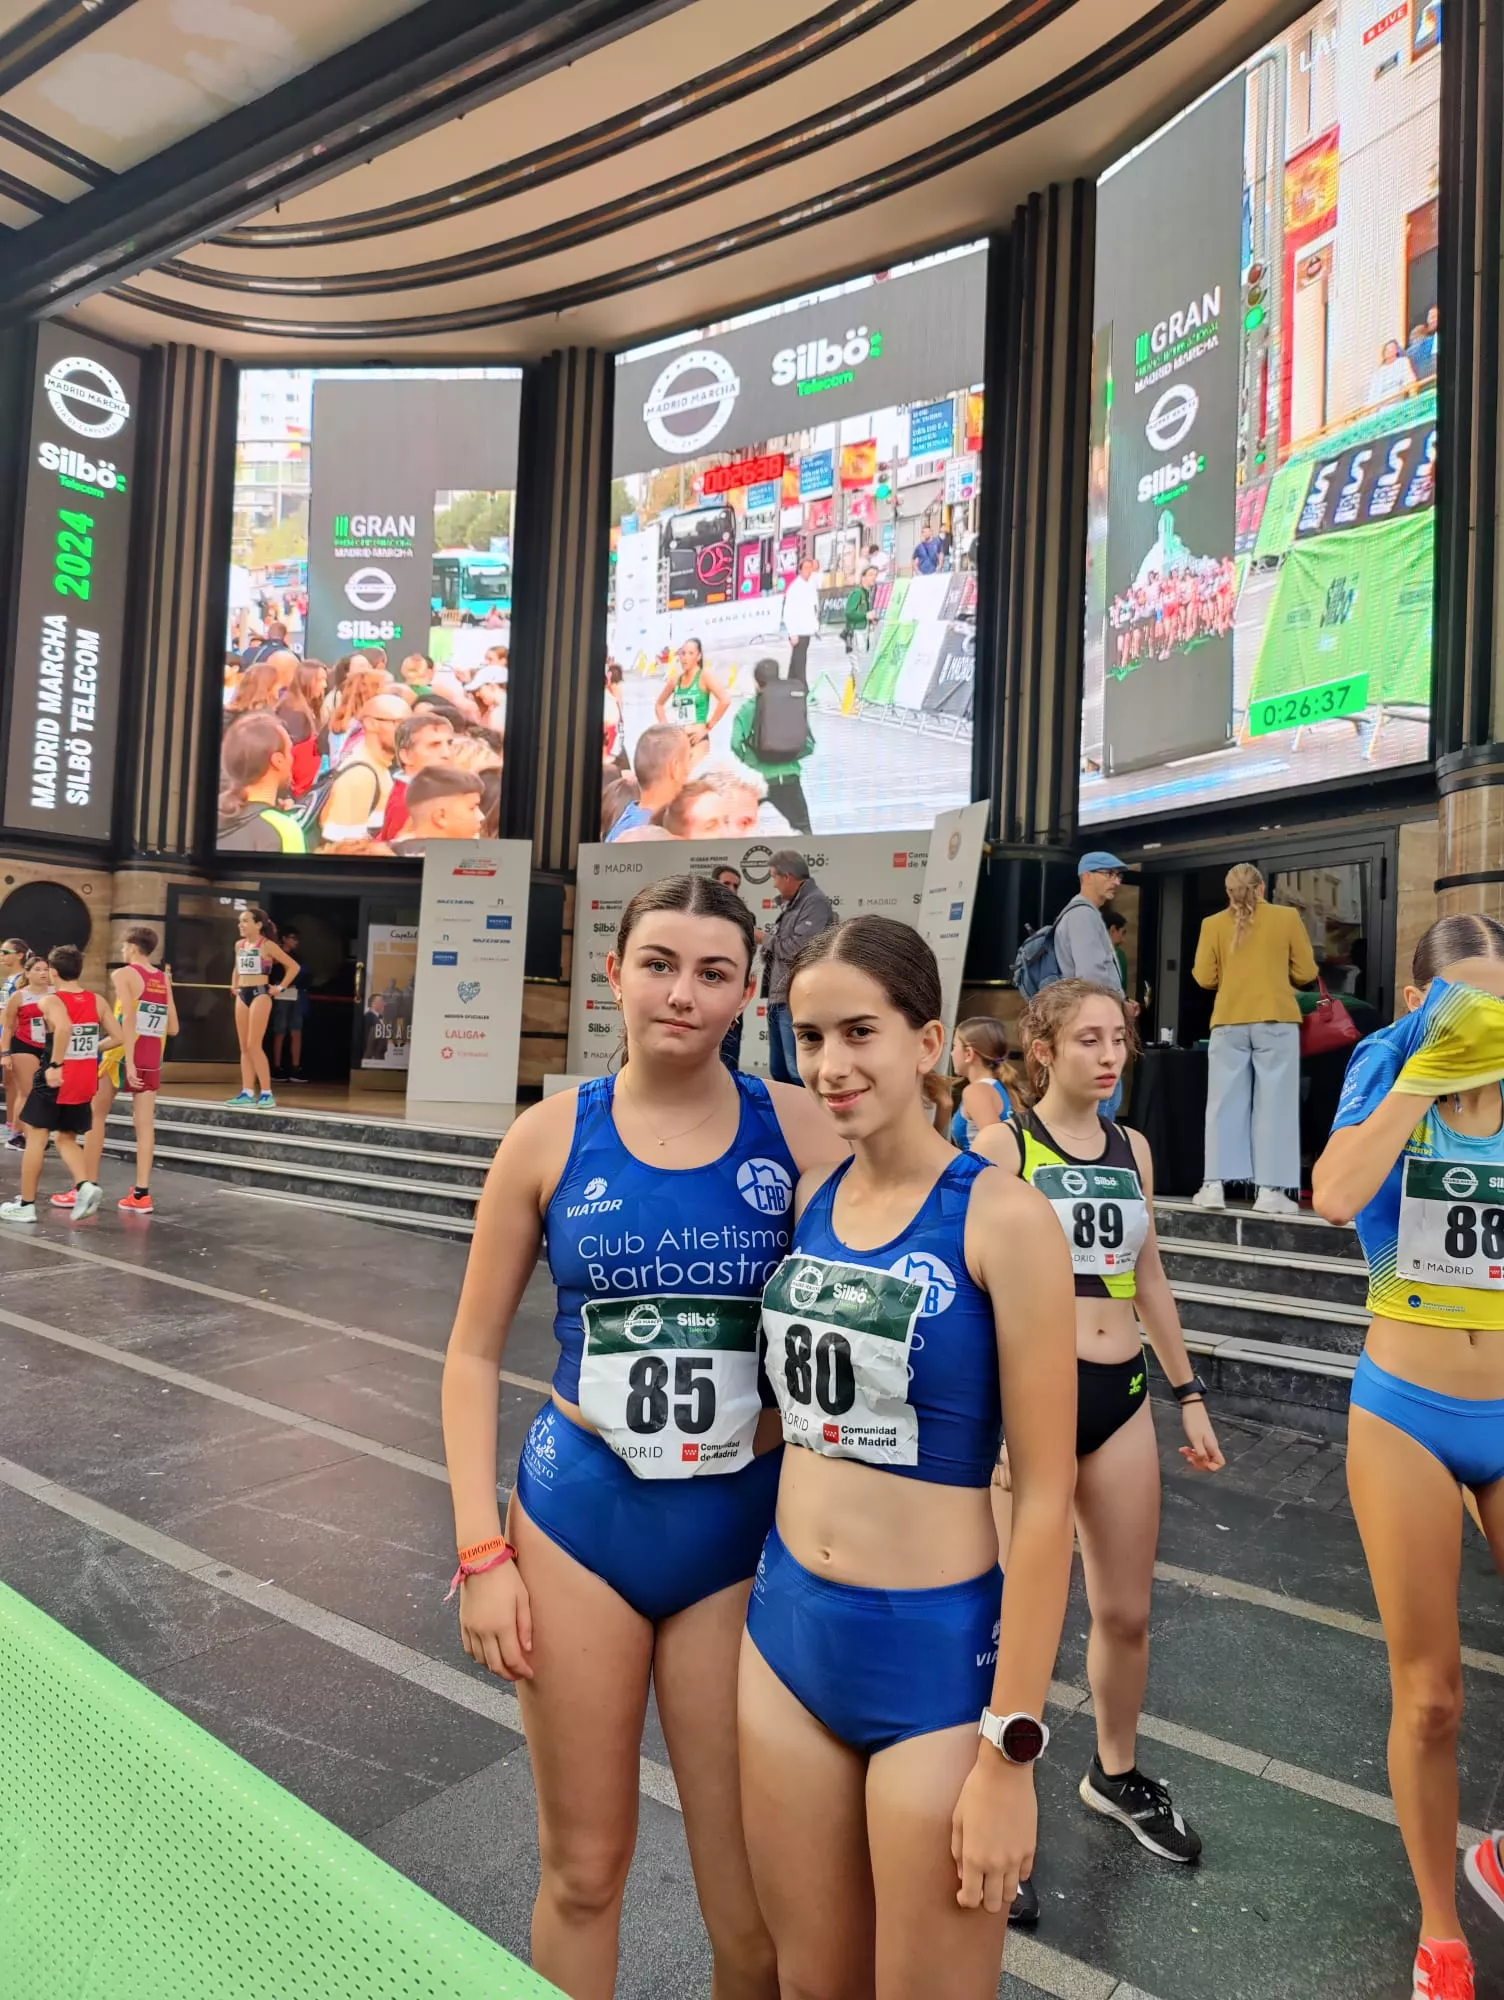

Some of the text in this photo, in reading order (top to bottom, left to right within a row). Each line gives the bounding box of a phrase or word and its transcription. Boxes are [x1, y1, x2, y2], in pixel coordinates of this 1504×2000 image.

[1378, 8, 1404, 32] LIVE
[1151, 286, 1221, 353] GRAN
[771, 326, 870, 387] Silbö
[47, 379, 127, 413] MADRID MARCHA
[646, 383, 737, 416] MADRID MARCHA
[38, 442, 117, 489] Silbö
[1137, 451, 1198, 503] Silbö
[350, 515, 416, 537] GRAN
[53, 508, 95, 600] 2024
[337, 620, 395, 640] Silbö
[31, 615, 67, 809] MADRID MARCHA
[64, 628, 100, 806] SILBÖ TELECOM
[1264, 685, 1351, 727] 0:26:37
[604, 863, 643, 873] MADRID
[593, 922, 615, 932] Silbö
[149, 1015, 161, 1029] 77
[375, 1023, 392, 1039] BIS
[588, 1023, 611, 1033] Silbö
[72, 1036, 93, 1051] 125
[566, 1199, 623, 1218] VIATOR
[755, 1185, 786, 1211] CAB
[1072, 1202, 1123, 1249] 89
[1445, 1205, 1504, 1260] 88
[578, 1225, 789, 1259] Club Atletismo
[1427, 1262, 1474, 1275] MADRID
[832, 1282, 868, 1304] Silbö
[677, 1312, 716, 1327] Silbö
[784, 1323, 856, 1416] 80
[626, 1356, 716, 1434] 85
[841, 1425, 897, 1435] Comunidad
[841, 1436, 897, 1447] de Madrid
